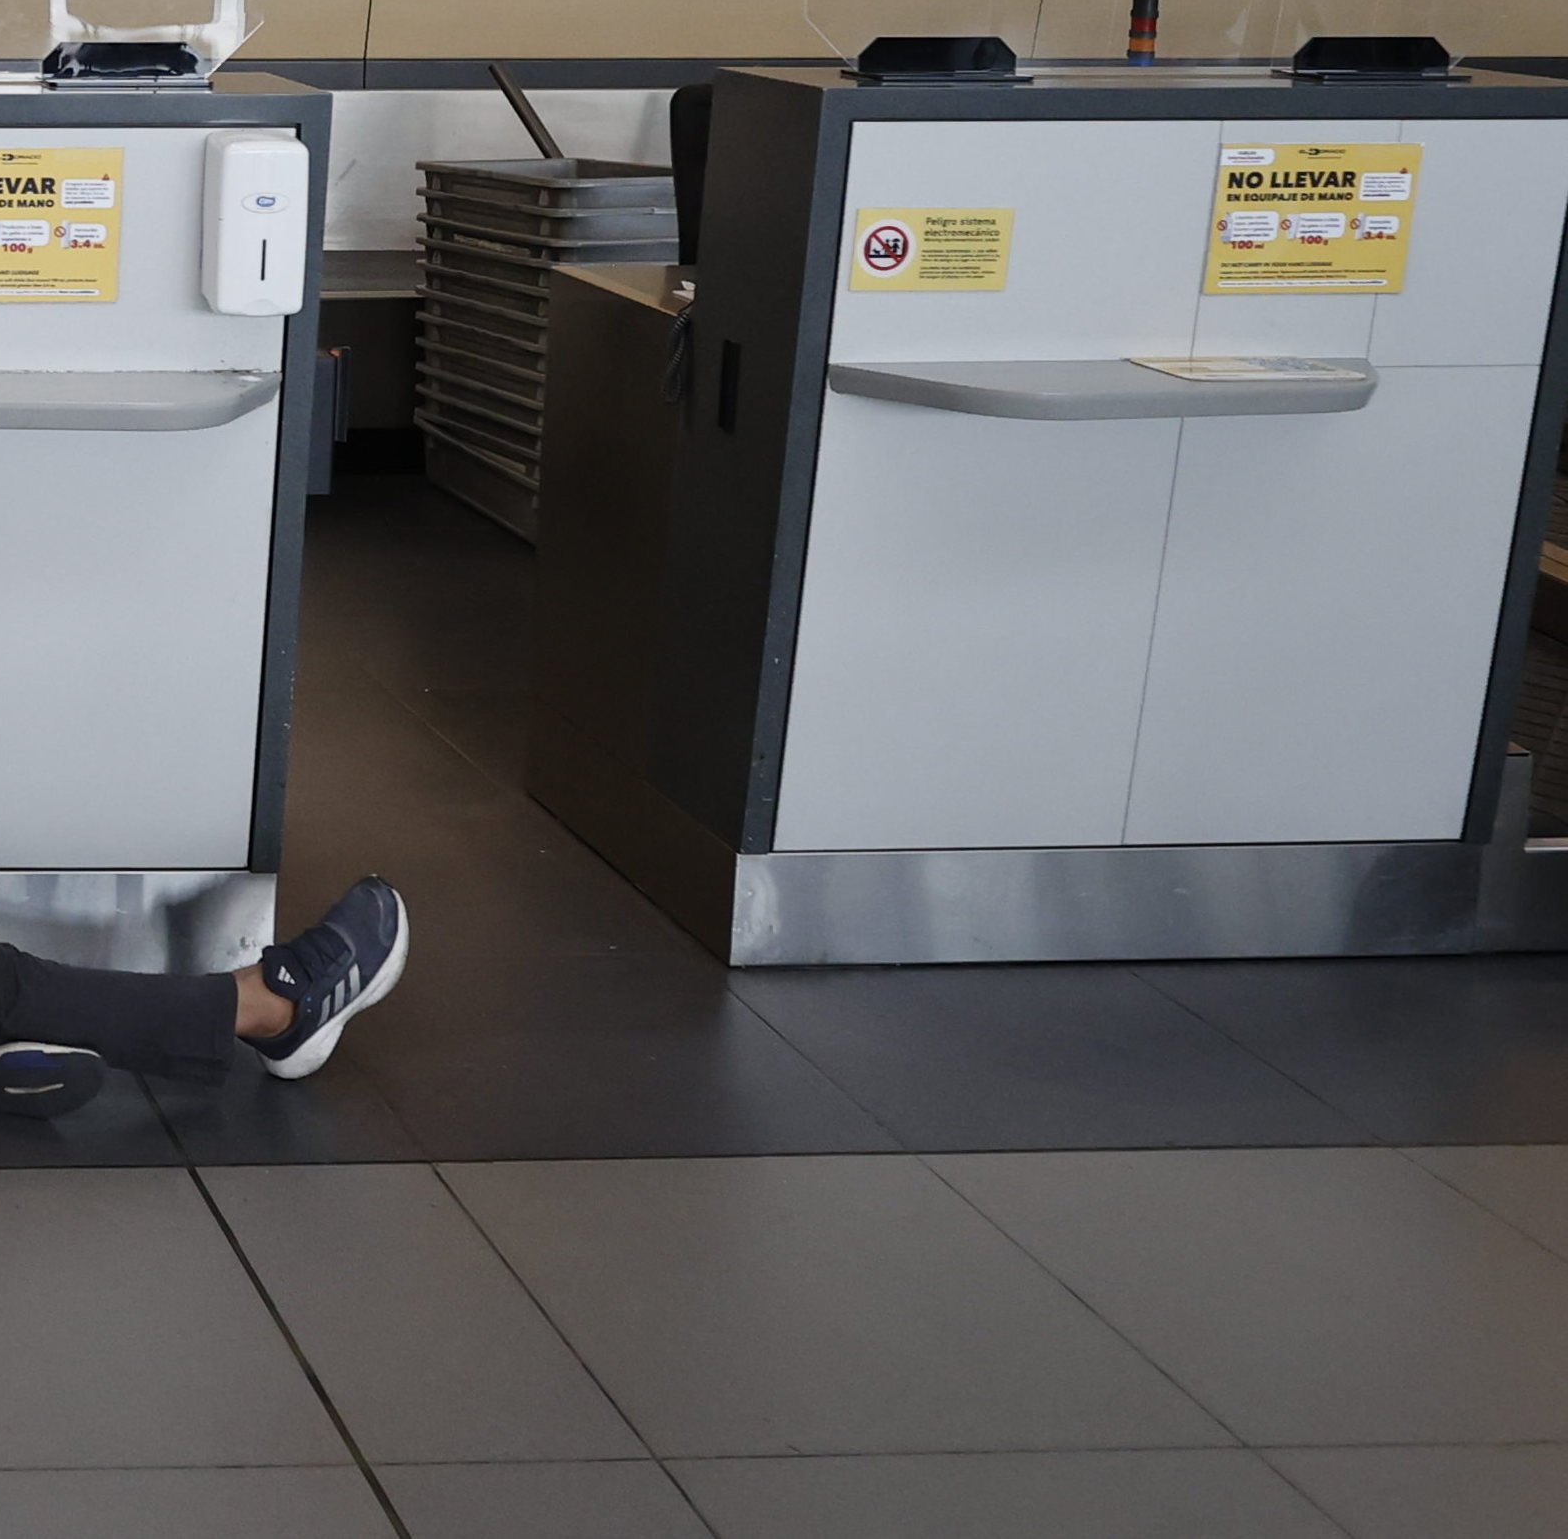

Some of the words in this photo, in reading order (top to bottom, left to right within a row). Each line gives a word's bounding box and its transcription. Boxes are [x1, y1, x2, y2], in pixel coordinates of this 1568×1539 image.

[1228, 171, 1263, 189] NO
[1270, 171, 1357, 188] LLEVAR
[17, 199, 55, 208] MANO
